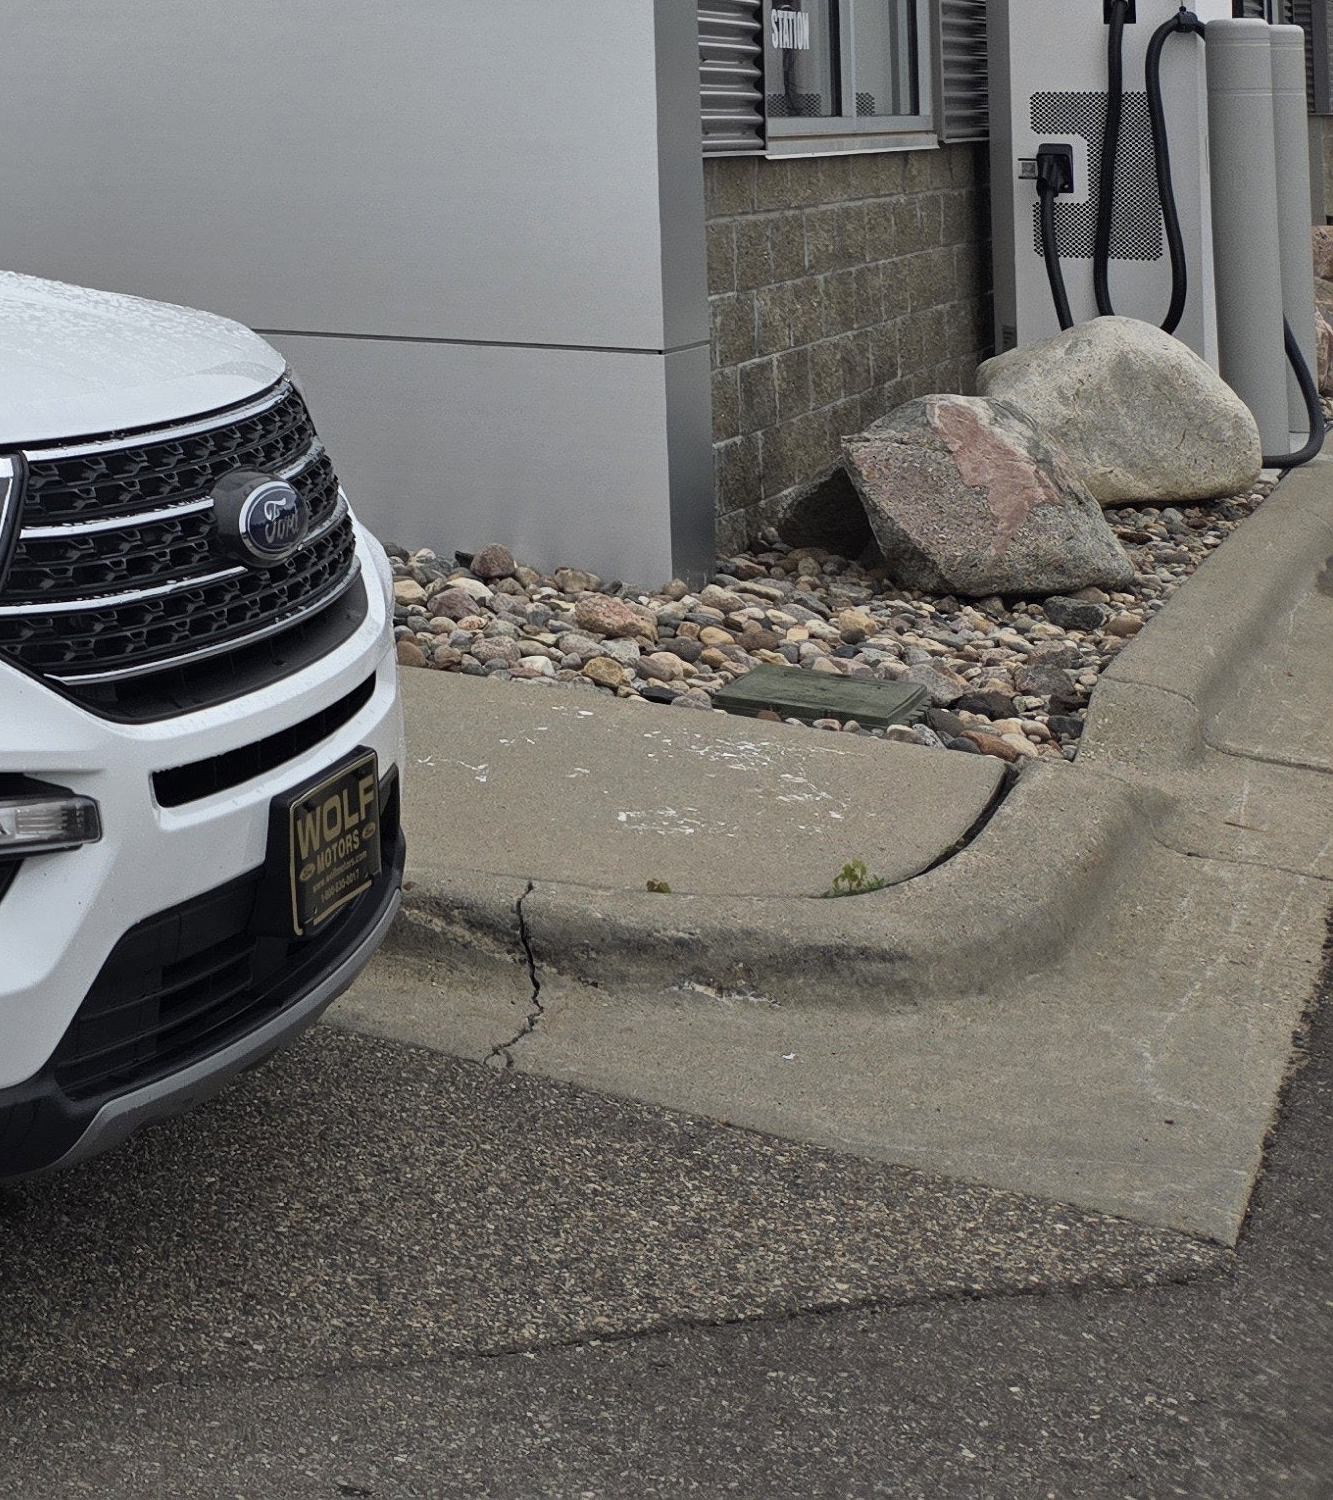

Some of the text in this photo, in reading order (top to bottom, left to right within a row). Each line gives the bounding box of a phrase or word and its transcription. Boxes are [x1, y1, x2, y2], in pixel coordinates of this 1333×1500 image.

[771, 9, 810, 50] STATION
[263, 497, 299, 544] Ford
[296, 774, 375, 860] WOLF
[316, 829, 360, 874] MOTORS
